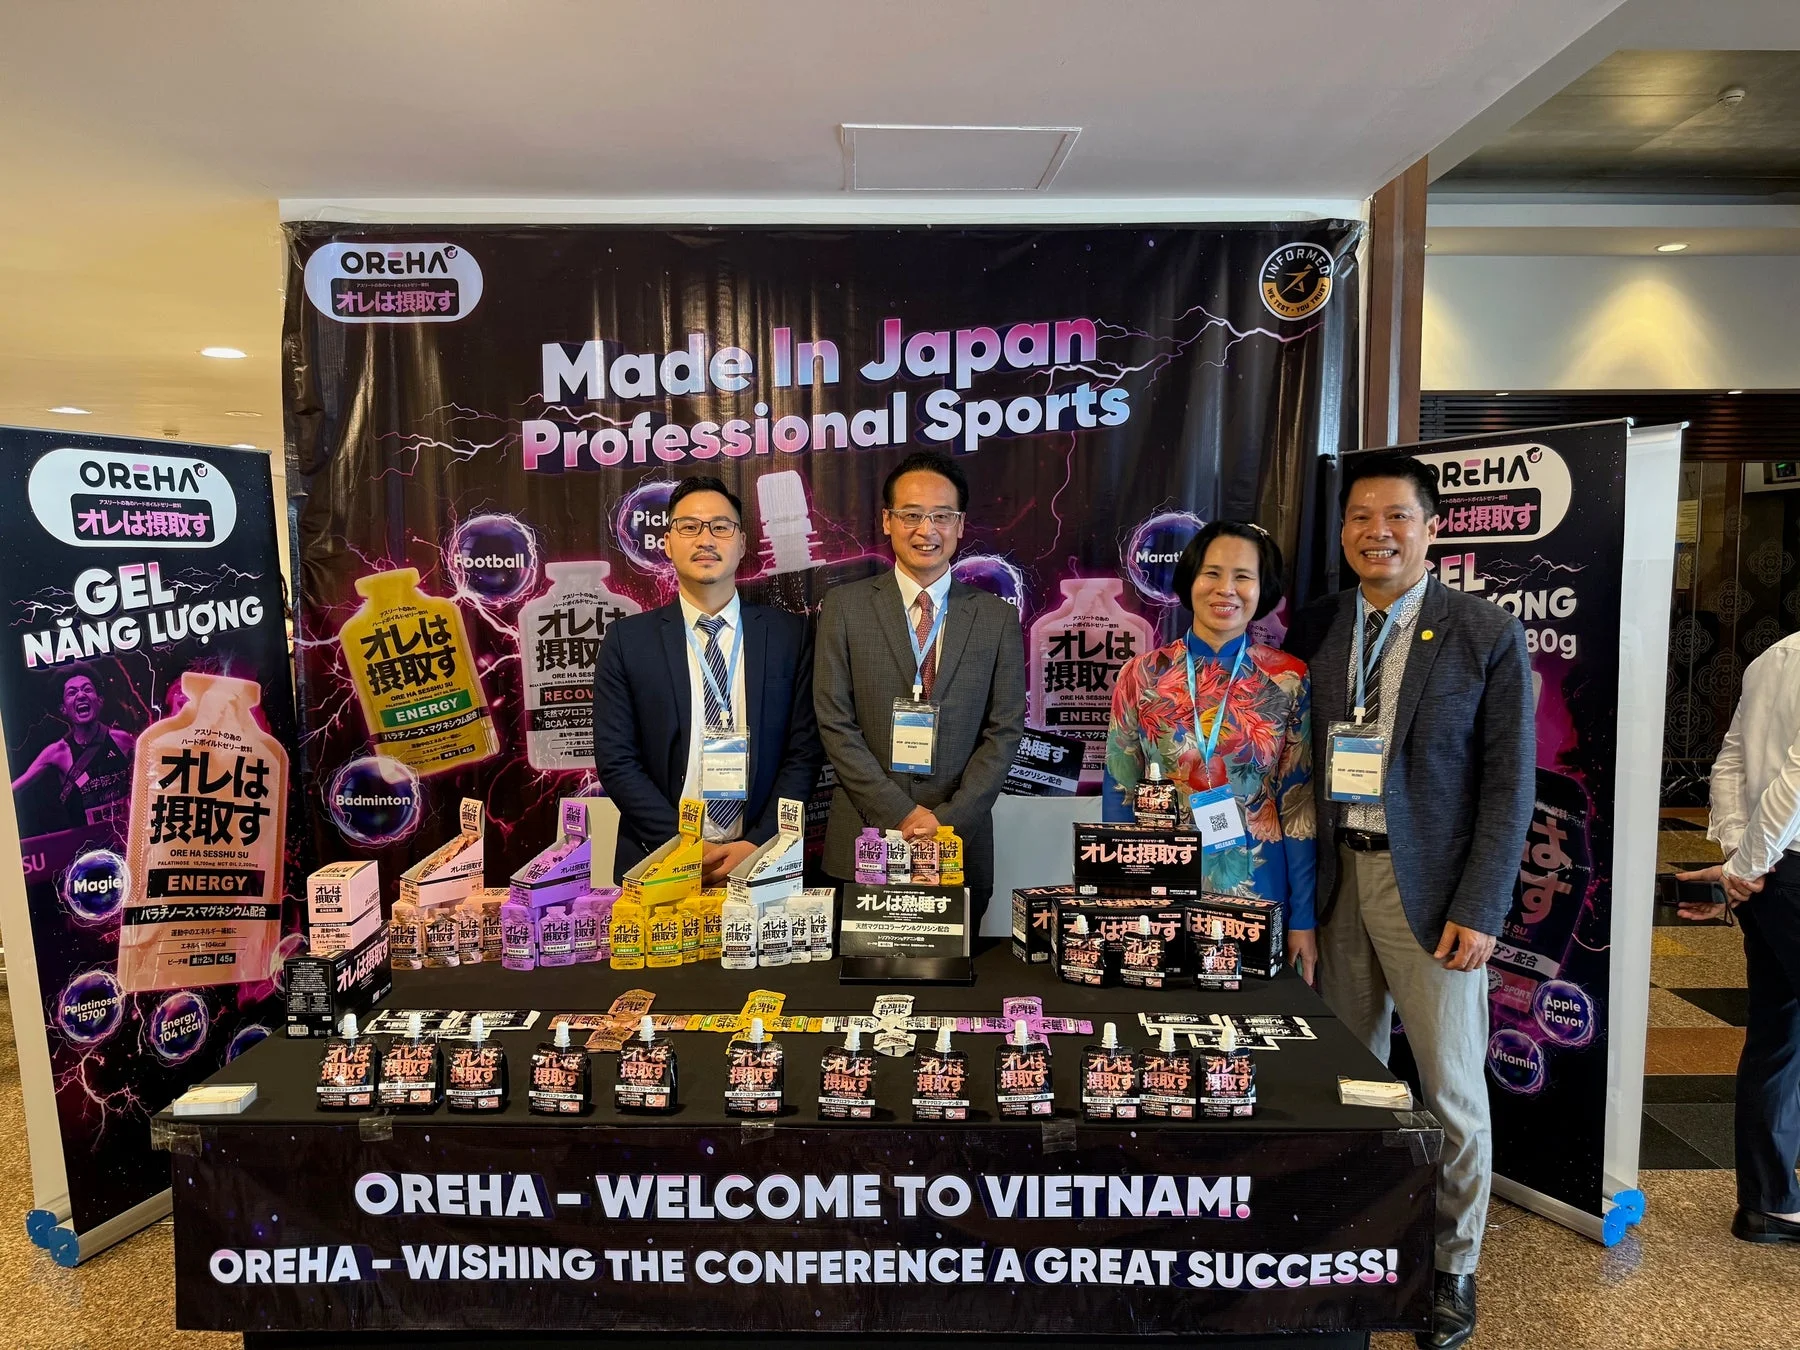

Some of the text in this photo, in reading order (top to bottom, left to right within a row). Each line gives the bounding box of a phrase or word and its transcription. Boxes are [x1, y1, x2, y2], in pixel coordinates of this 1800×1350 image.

[341, 251, 448, 274] OREHA
[1265, 248, 1331, 278] INFORMED
[336, 290, 456, 313] オレは摂取す
[1267, 282, 1327, 312] WE TEST YOU TRUST
[541, 317, 1097, 403] Made In Japan
[522, 382, 1131, 471] Professional Sports
[80, 460, 199, 493] OREHA
[77, 509, 210, 538] オレは摂取す
[453, 553, 526, 569] Football
[74, 562, 175, 615] GEL
[23, 596, 264, 668] NĂNG LƯỢNG
[360, 614, 452, 660] オレは
[1048, 630, 1136, 660] オレは
[366, 645, 456, 696] 摂取す
[390, 692, 406, 701] ORE
[406, 690, 417, 699] HA
[418, 685, 444, 695] SESSHU
[395, 697, 458, 723] ENERGY
[158, 749, 269, 799] オレは
[336, 795, 411, 806] Badminton
[150, 795, 270, 846] 摂取す
[170, 849, 249, 859] ORE HA SESSHU SU
[1080, 843, 1198, 865] オレは摂取す
[73, 875, 124, 894] Magie
[167, 875, 248, 891] ENERGY
[315, 886, 341, 895] オレは
[856, 894, 951, 914] オレは熟睡す
[140, 906, 267, 921] パラチノース・マグネシウム配合
[391, 925, 416, 935] オレは
[427, 922, 454, 933] オレは
[506, 926, 529, 935] オレは
[543, 923, 570, 932] オレは
[614, 924, 640, 934] オレは
[652, 922, 678, 931] オレは
[727, 922, 752, 932] オレは
[762, 920, 788, 930] オレは
[336, 936, 390, 994] オレは摂取す
[1503, 985, 1532, 999] SPORT
[64, 996, 118, 1016] Palatinose
[1544, 995, 1581, 1013] Apple
[77, 1007, 107, 1023] 15700
[161, 1010, 197, 1032] Energy
[1544, 1010, 1584, 1028] Flavor
[159, 1018, 201, 1044] 104 kcal
[326, 1047, 370, 1063] オレは
[388, 1046, 432, 1059] オレは
[622, 1048, 667, 1062] オレは
[731, 1050, 779, 1067] オレは
[1491, 1047, 1538, 1071] Vitamin
[322, 1062, 370, 1080] 摂取す
[384, 1058, 433, 1076] 摂取す
[536, 1055, 579, 1069] オレは
[620, 1061, 667, 1079] 摂取す
[1002, 1053, 1047, 1071] オレは
[1088, 1056, 1134, 1073] オレは
[1145, 1057, 1190, 1073] オレは
[1207, 1057, 1252, 1074] オレは
[450, 1066, 497, 1083] 摂取す
[533, 1067, 579, 1086] 摂取す
[729, 1066, 778, 1085] 摂取す
[823, 1073, 872, 1092] 摂取す
[917, 1073, 965, 1093] 摂取す
[1000, 1068, 1048, 1089] 摂取す
[1087, 1072, 1136, 1090] 摂取す
[1143, 1072, 1191, 1090] 摂取す
[1205, 1073, 1253, 1091] 摂取す
[354, 1172, 544, 1216] OREHA
[596, 1174, 881, 1219] WELCOME
[894, 1175, 972, 1217] TO
[987, 1174, 1251, 1219] VIETNAM!
[209, 1245, 361, 1284] OREHA
[401, 1244, 596, 1280] WISHING
[604, 1250, 684, 1282] THE
[696, 1247, 984, 1284] CONFERENCE
[994, 1247, 1024, 1283] A
[1034, 1247, 1177, 1286] GREAT
[1187, 1247, 1398, 1289] SUCCESS!
